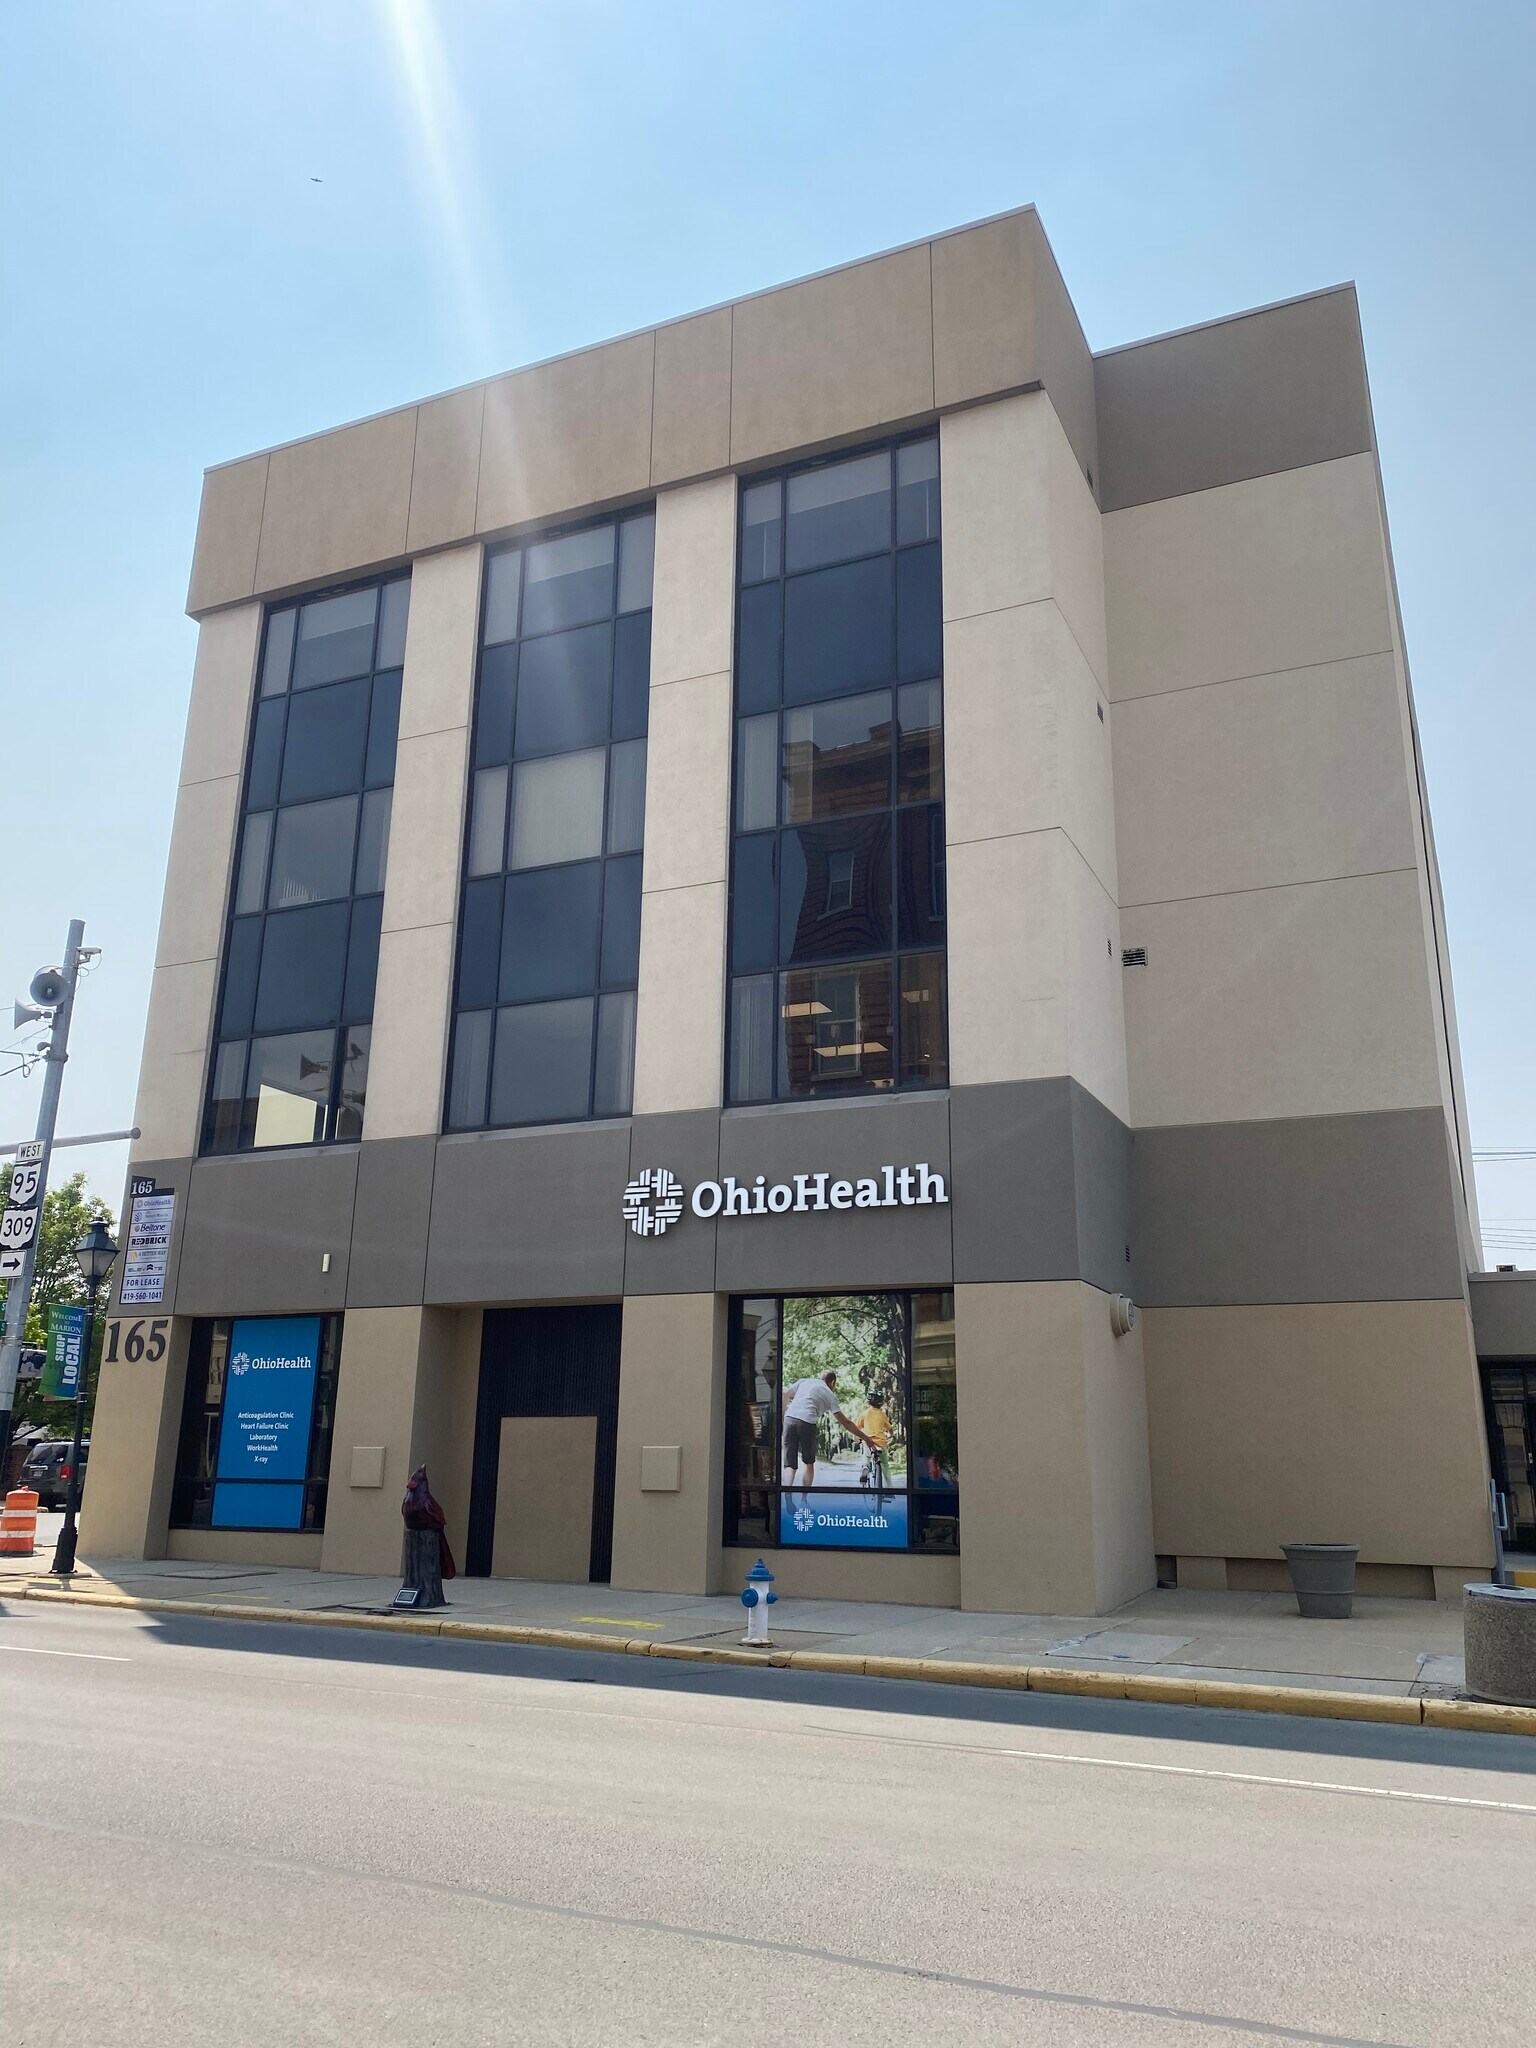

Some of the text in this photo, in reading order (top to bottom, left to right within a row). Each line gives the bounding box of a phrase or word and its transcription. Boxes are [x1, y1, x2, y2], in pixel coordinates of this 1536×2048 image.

[20, 1144, 42, 1158] WEST
[13, 1170, 38, 1194] 95
[131, 1180, 153, 1195] 165
[691, 1163, 949, 1218] OhioHealth
[3, 1217, 34, 1238] 309
[140, 1224, 166, 1232] Beltone
[131, 1236, 167, 1246] REDBRICK
[141, 1278, 160, 1286] LEASE
[123, 1291, 162, 1301] 419-560-1041
[51, 1311, 83, 1322] WELCOME
[50, 1323, 82, 1334] MARION
[105, 1319, 169, 1363] 165
[55, 1334, 67, 1362] SHOP
[62, 1336, 81, 1385] LOCAL
[251, 1356, 312, 1370] OhioHealth
[238, 1411, 294, 1420] Anticoagulation Clinic
[240, 1422, 289, 1430] Heart Failure Clinic
[249, 1433, 278, 1442] Laboratory
[247, 1444, 278, 1452] WorkHealth
[254, 1455, 268, 1464] X-ray
[817, 1515, 888, 1529] OhioHealth
